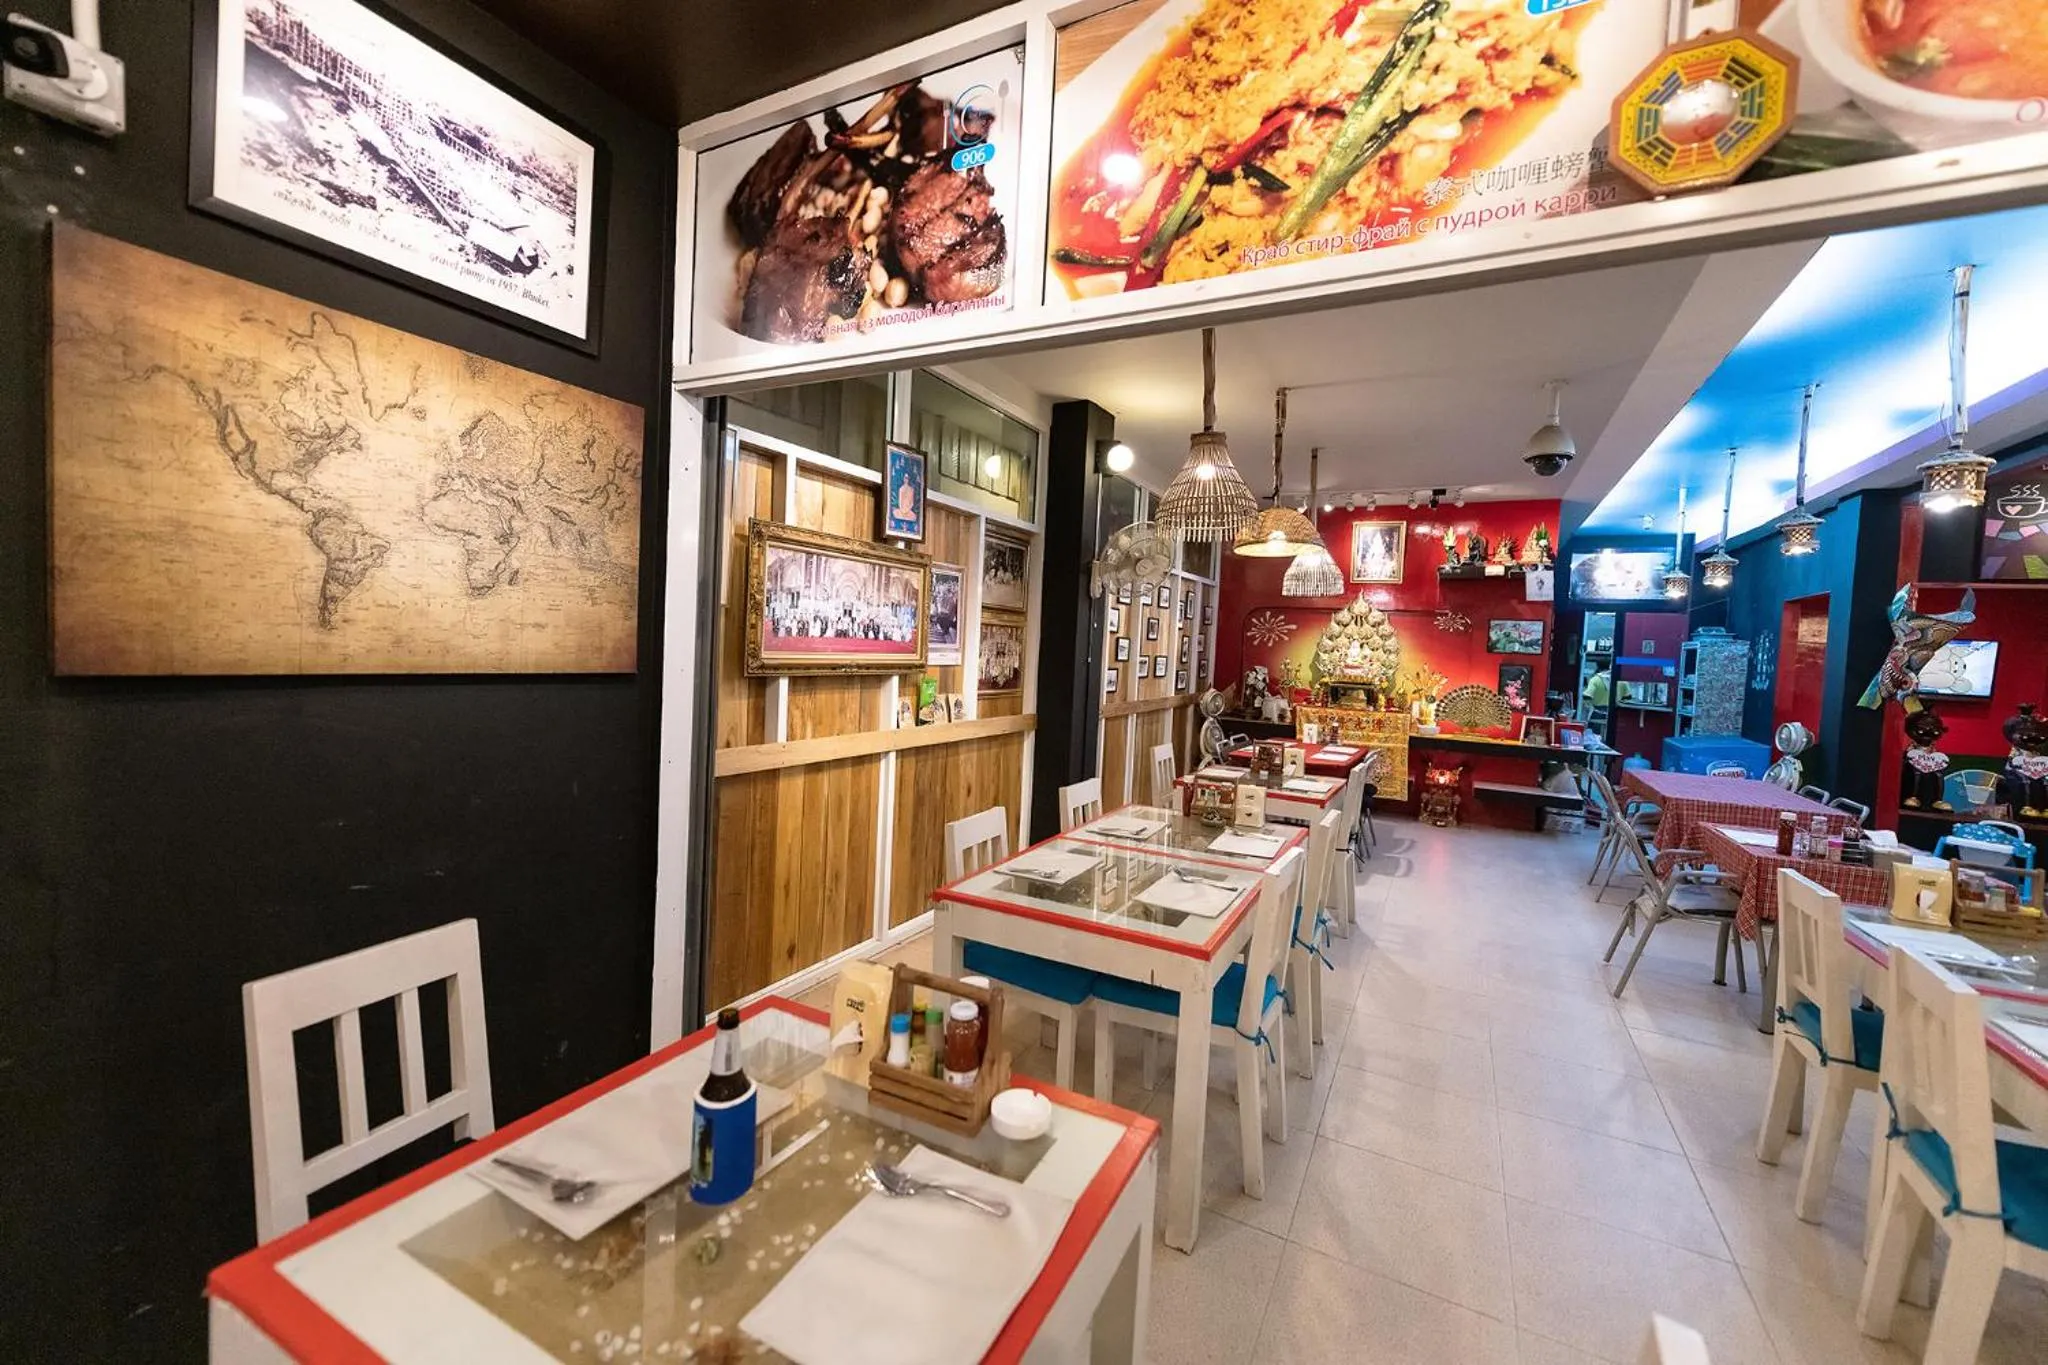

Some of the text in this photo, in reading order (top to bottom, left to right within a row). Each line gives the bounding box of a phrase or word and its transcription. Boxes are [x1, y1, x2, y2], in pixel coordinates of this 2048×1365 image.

[963, 150, 986, 166] 906
[1240, 186, 1617, 265] Краб стир-фрай с пудрой карри
[876, 305, 934, 326] молодой
[936, 295, 1005, 316] баранины
